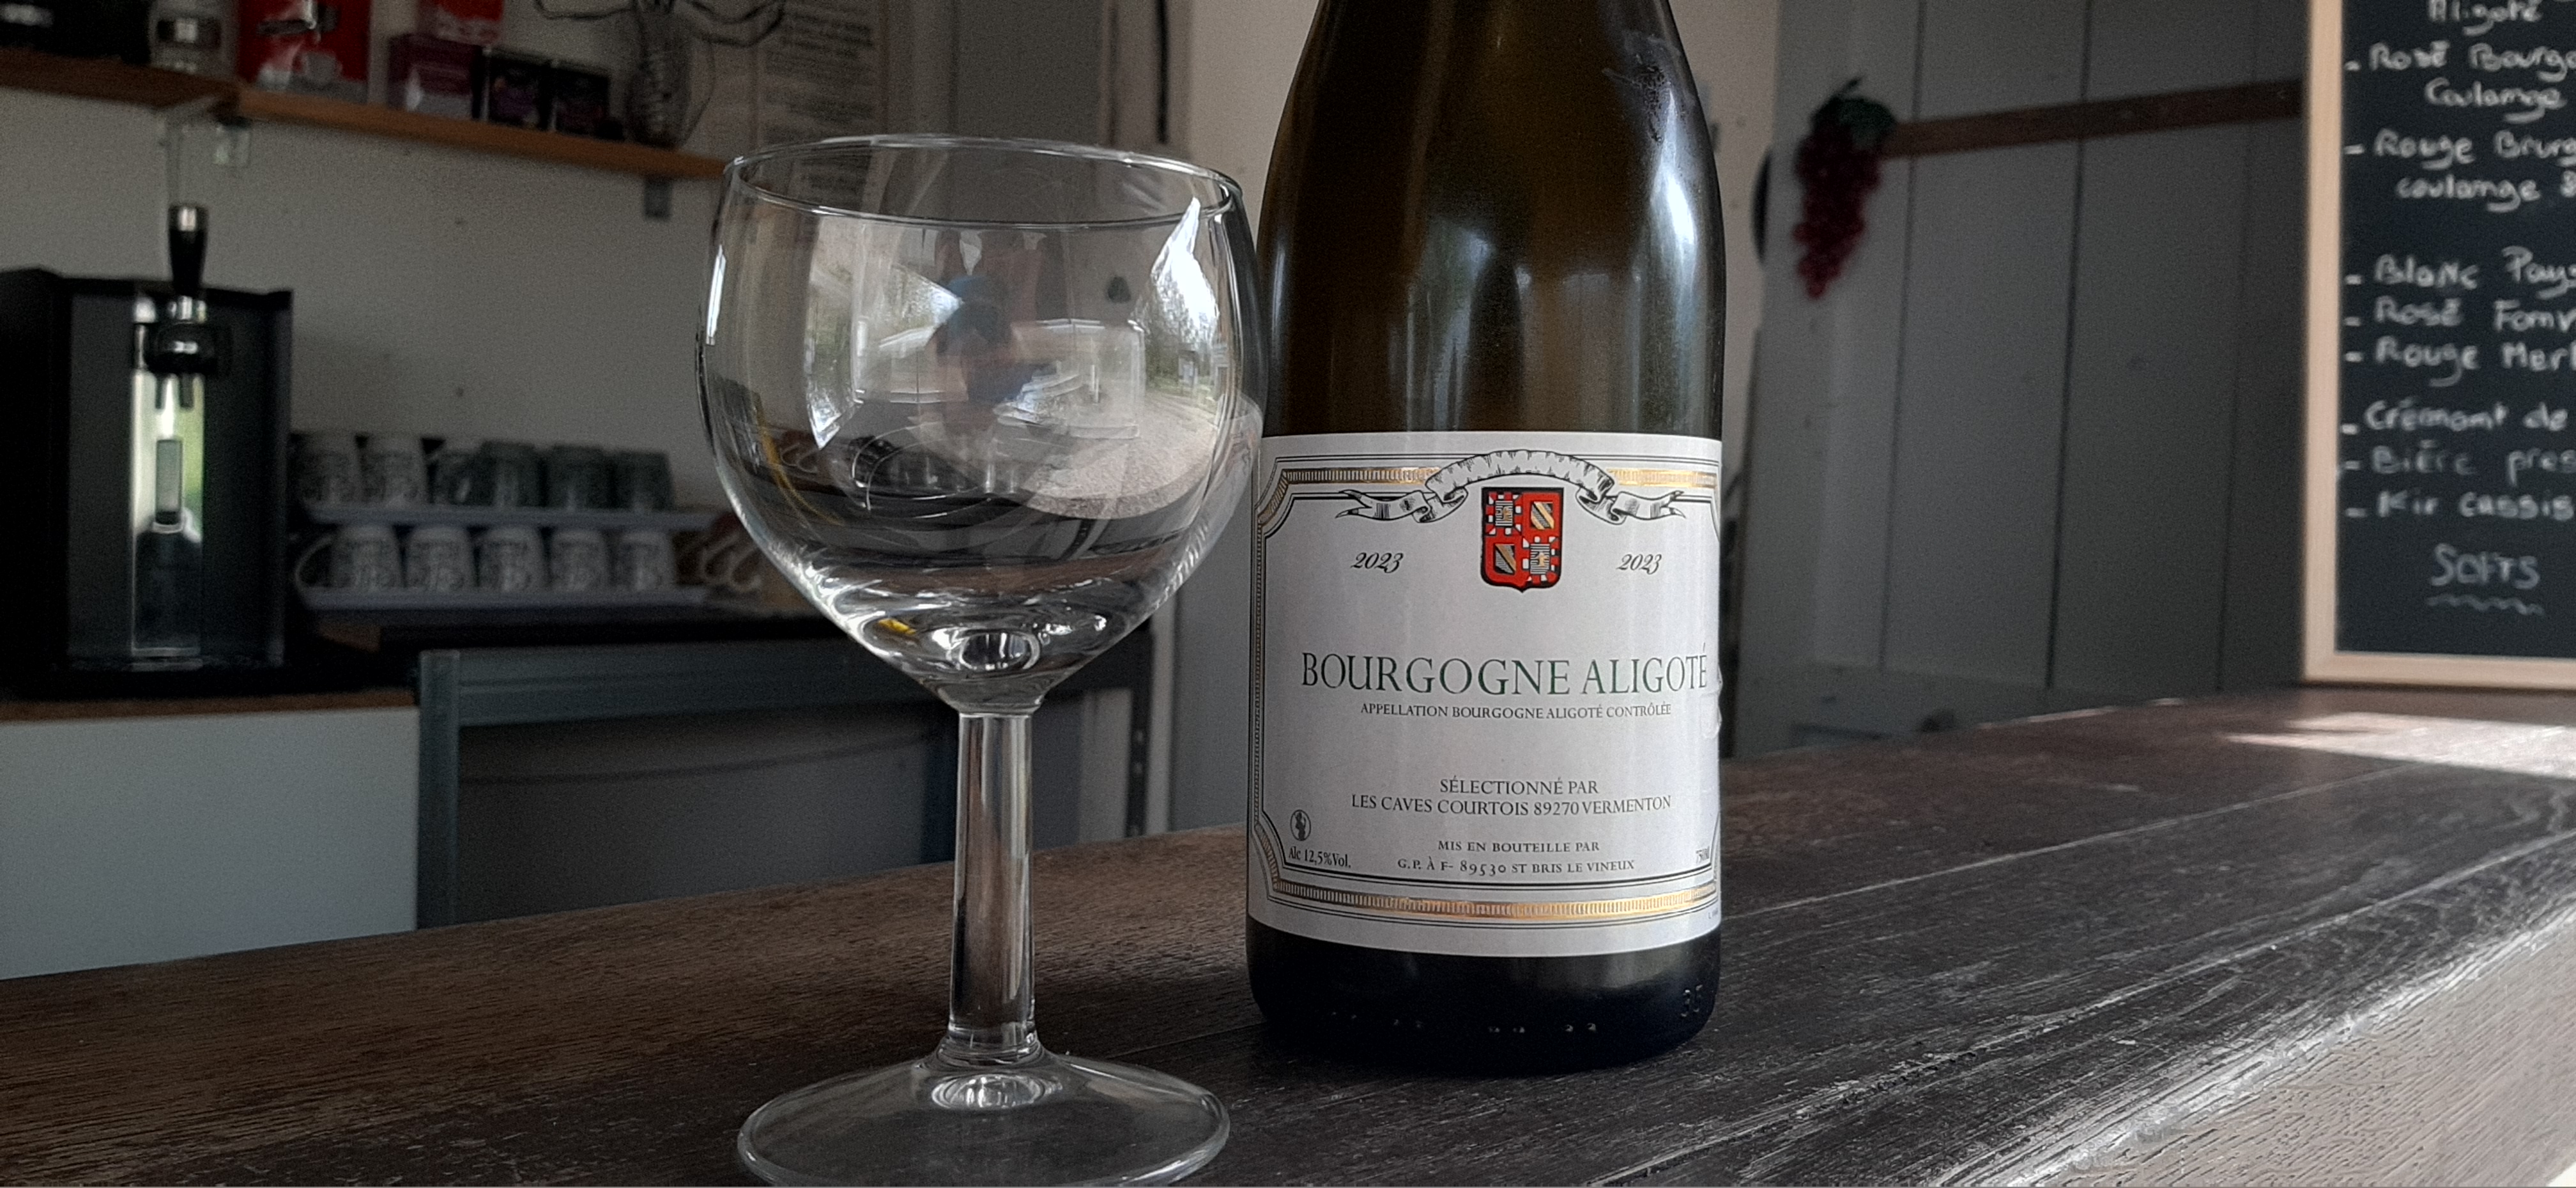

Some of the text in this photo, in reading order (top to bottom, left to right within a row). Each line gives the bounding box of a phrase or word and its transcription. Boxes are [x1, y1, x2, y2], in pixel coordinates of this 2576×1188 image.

[2373, 128, 2476, 171] Rouge
[2374, 335, 2479, 388] Rouge
[2523, 401, 2569, 432] de
[1351, 552, 1404, 574] 2023
[1616, 553, 1662, 574] 2023
[1301, 642, 1708, 695] BOURGOGNE ALIGOTÉ
[1360, 701, 1672, 719] APPELLATION BOURGOGNE ALIGOTÉ CONTRÔLÉE
[1439, 775, 1599, 795] SÉLECTIONNÉ PAR
[1351, 794, 1672, 816] LES CAVES COURTOIS 89270 VERMENTON
[1438, 840, 1600, 853] MIS EN BOUTEILLE PAR
[1426, 856, 1436, 871] À
[1459, 860, 1506, 876] 89530
[1511, 864, 1528, 873] ST
[1532, 863, 1563, 874] BRIS
[1567, 863, 1583, 873] LE
[1587, 860, 1635, 872] VINEUX
